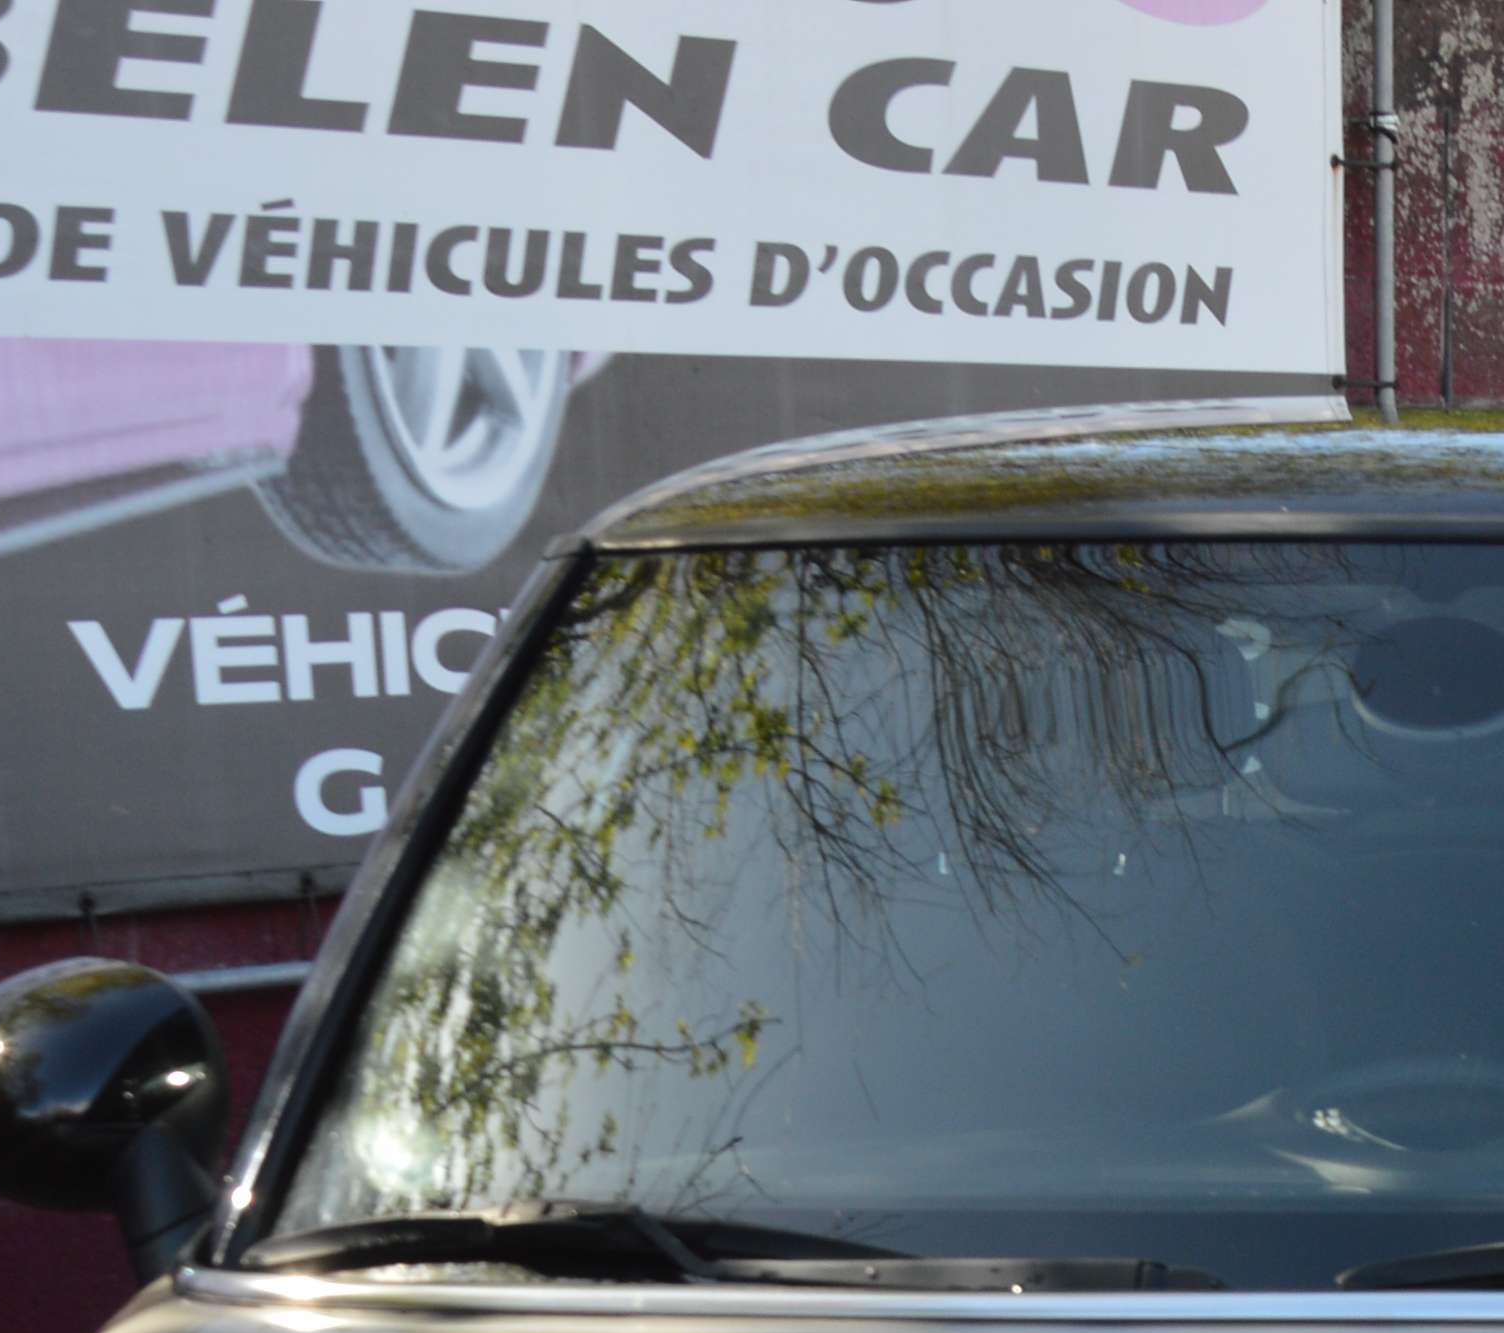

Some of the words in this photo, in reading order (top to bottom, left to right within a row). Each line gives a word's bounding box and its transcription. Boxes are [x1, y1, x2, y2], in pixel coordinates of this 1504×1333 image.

[828, 57, 1250, 196] CAR
[160, 198, 716, 304] VÉHICULES
[749, 240, 1233, 327] D'OCCASION
[67, 594, 510, 710] VÉHIC
